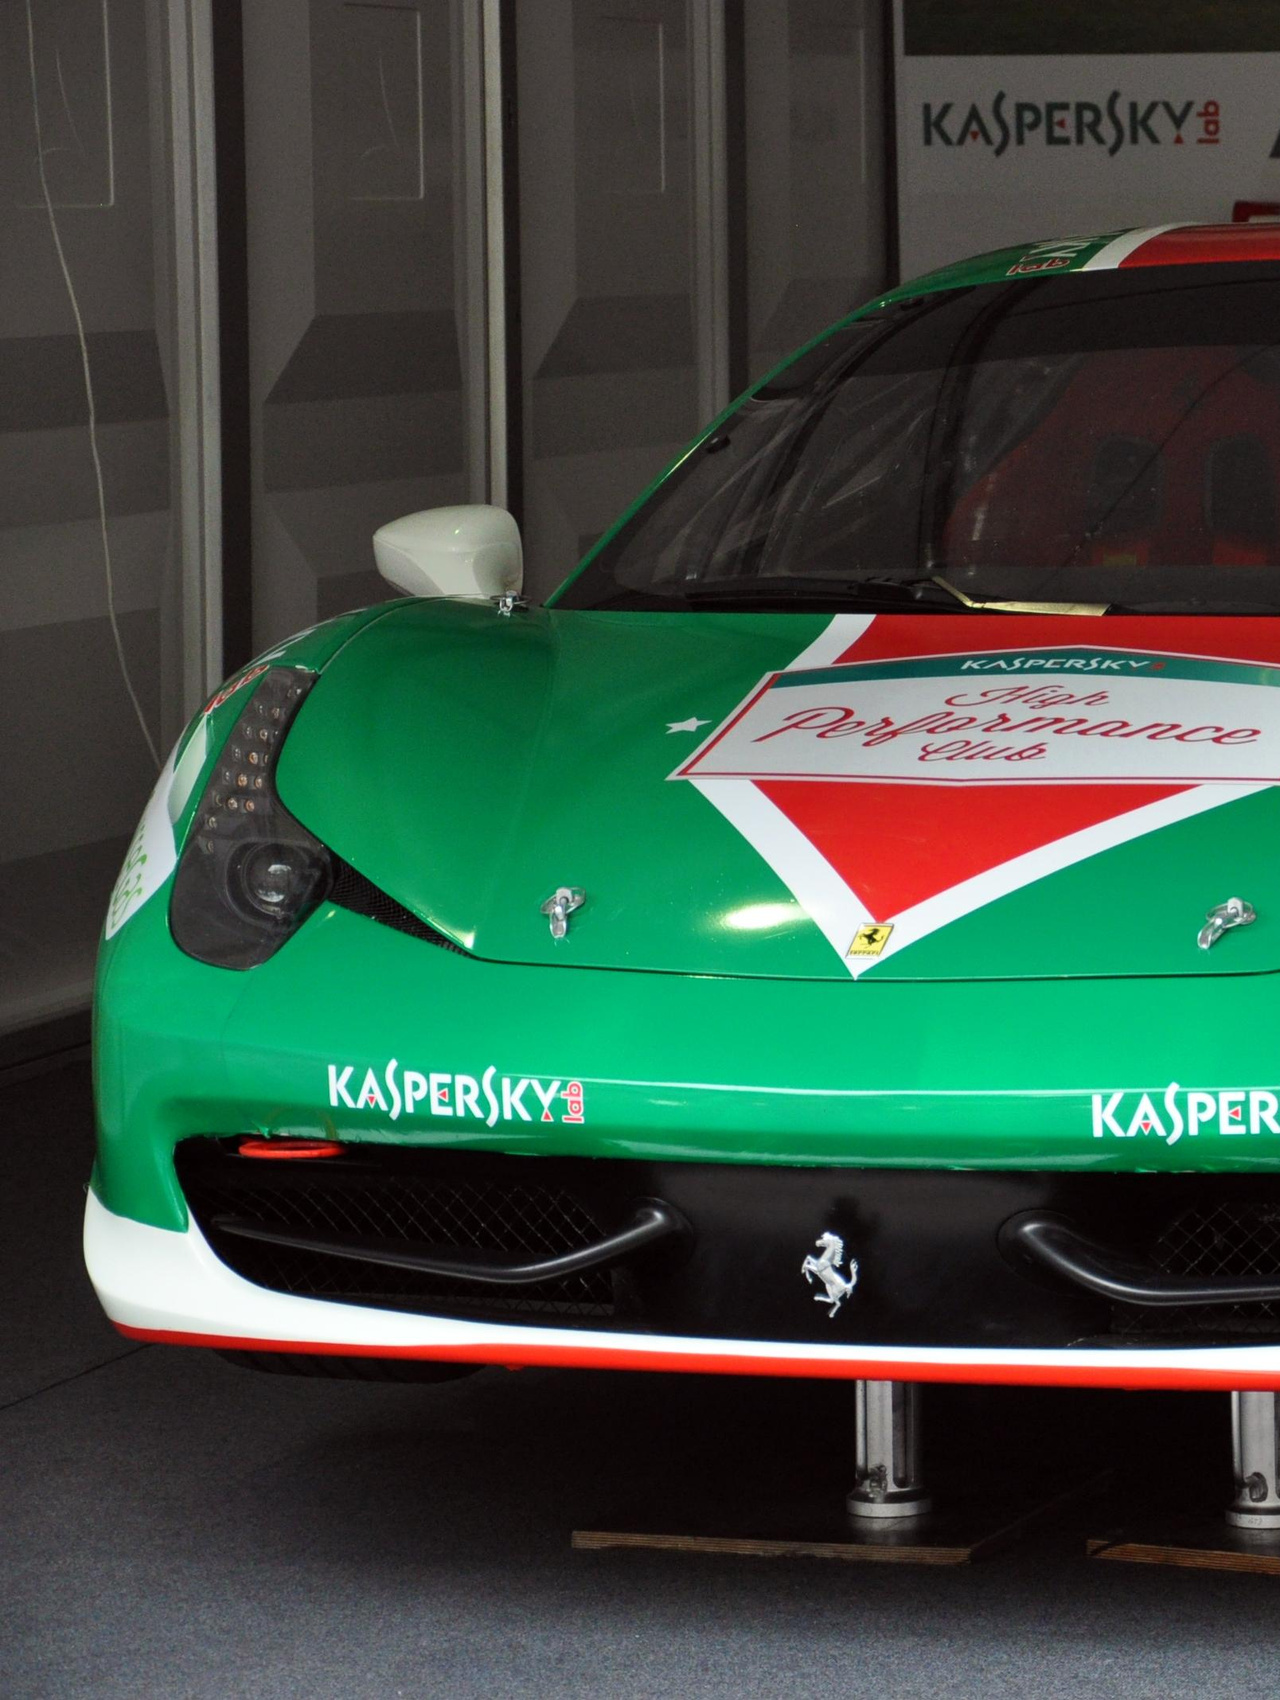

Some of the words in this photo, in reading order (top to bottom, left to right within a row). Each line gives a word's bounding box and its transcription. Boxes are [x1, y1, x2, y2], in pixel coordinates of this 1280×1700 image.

[923, 90, 1194, 157] KASPERSKY
[1197, 100, 1219, 144] lab
[961, 657, 1150, 671] KASPERSKY
[944, 684, 1110, 709] High
[750, 705, 1262, 748] Performance
[916, 739, 1047, 762] Club
[328, 1058, 561, 1128] KASPERSKY
[560, 1080, 585, 1124] lab
